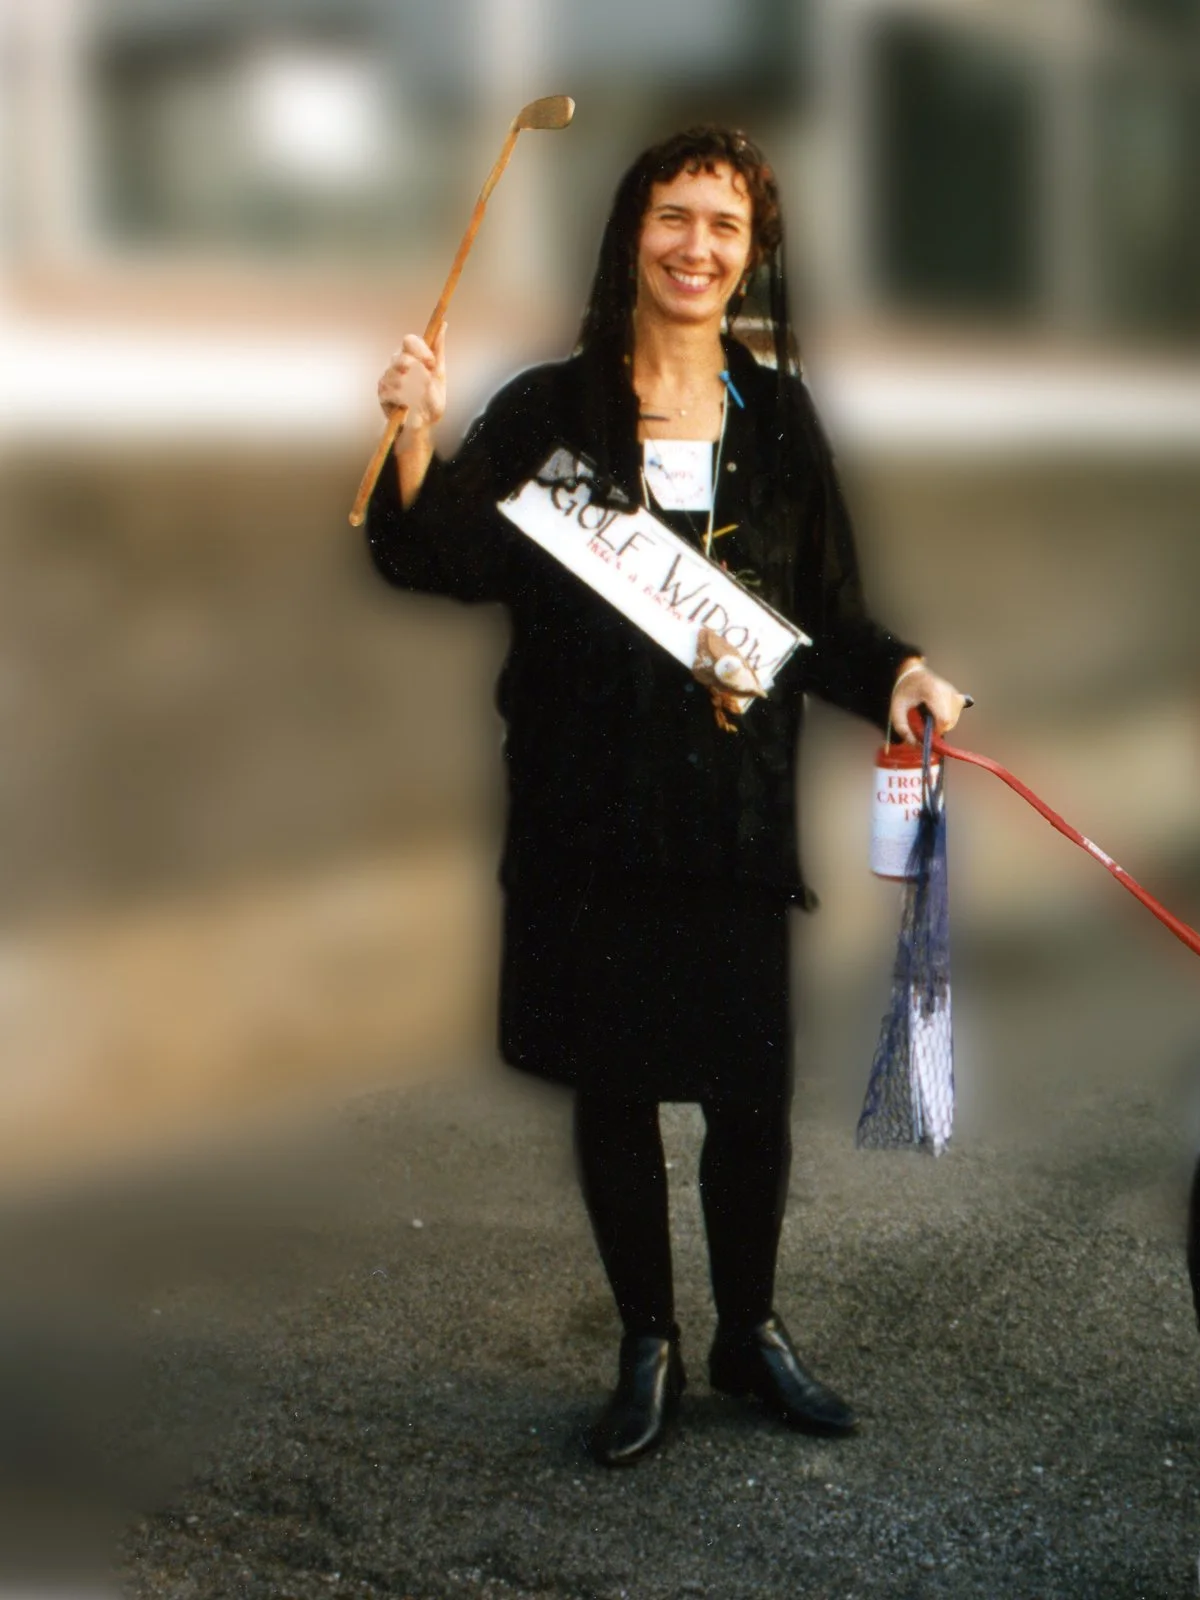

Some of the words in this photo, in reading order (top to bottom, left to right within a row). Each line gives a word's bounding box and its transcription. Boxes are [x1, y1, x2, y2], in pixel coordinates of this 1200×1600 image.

[551, 484, 655, 556] GOLF
[660, 554, 778, 671] WIDOW
[888, 776, 941, 789] FRO
[877, 791, 922, 805] CARN
[904, 808, 921, 821] 19
